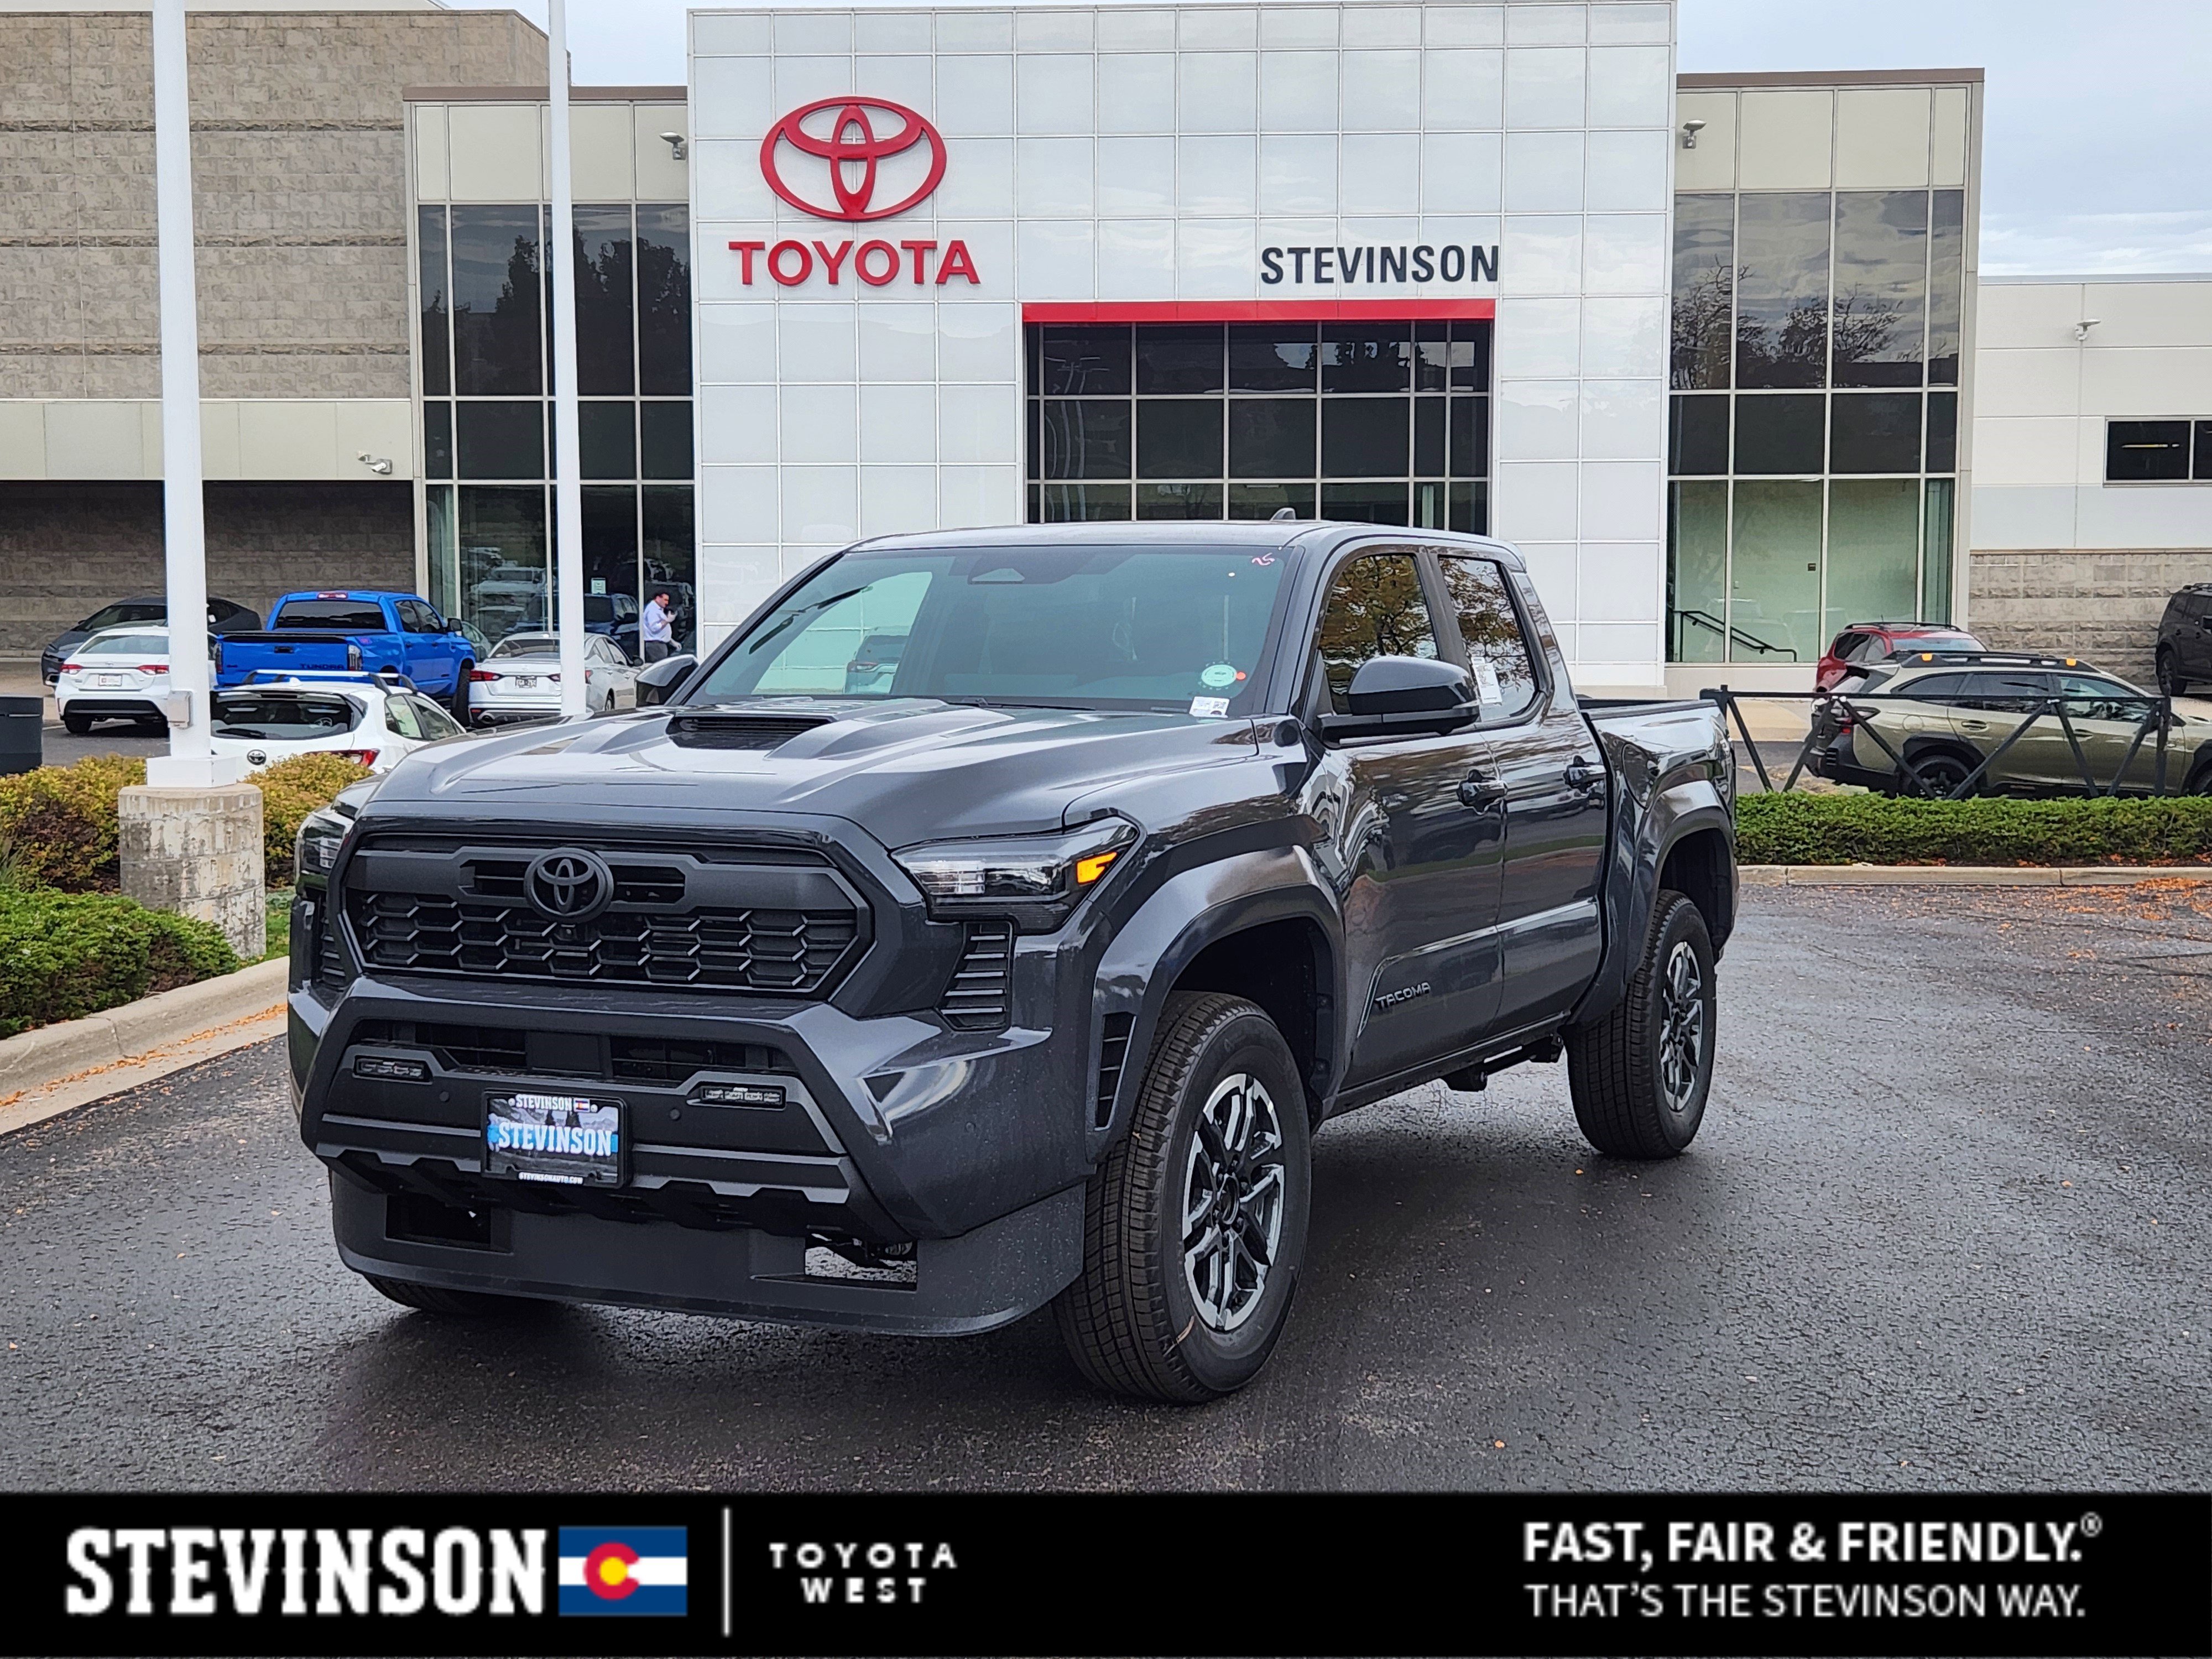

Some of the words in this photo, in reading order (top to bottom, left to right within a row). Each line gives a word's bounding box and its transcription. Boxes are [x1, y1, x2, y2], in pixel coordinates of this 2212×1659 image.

[728, 239, 981, 286] TOYOTA
[1261, 245, 1499, 284] STEVINSON
[1375, 982, 1431, 1009] TACOMA
[515, 1094, 572, 1111] STEVINSON
[498, 1122, 612, 1156] STEVINSON
